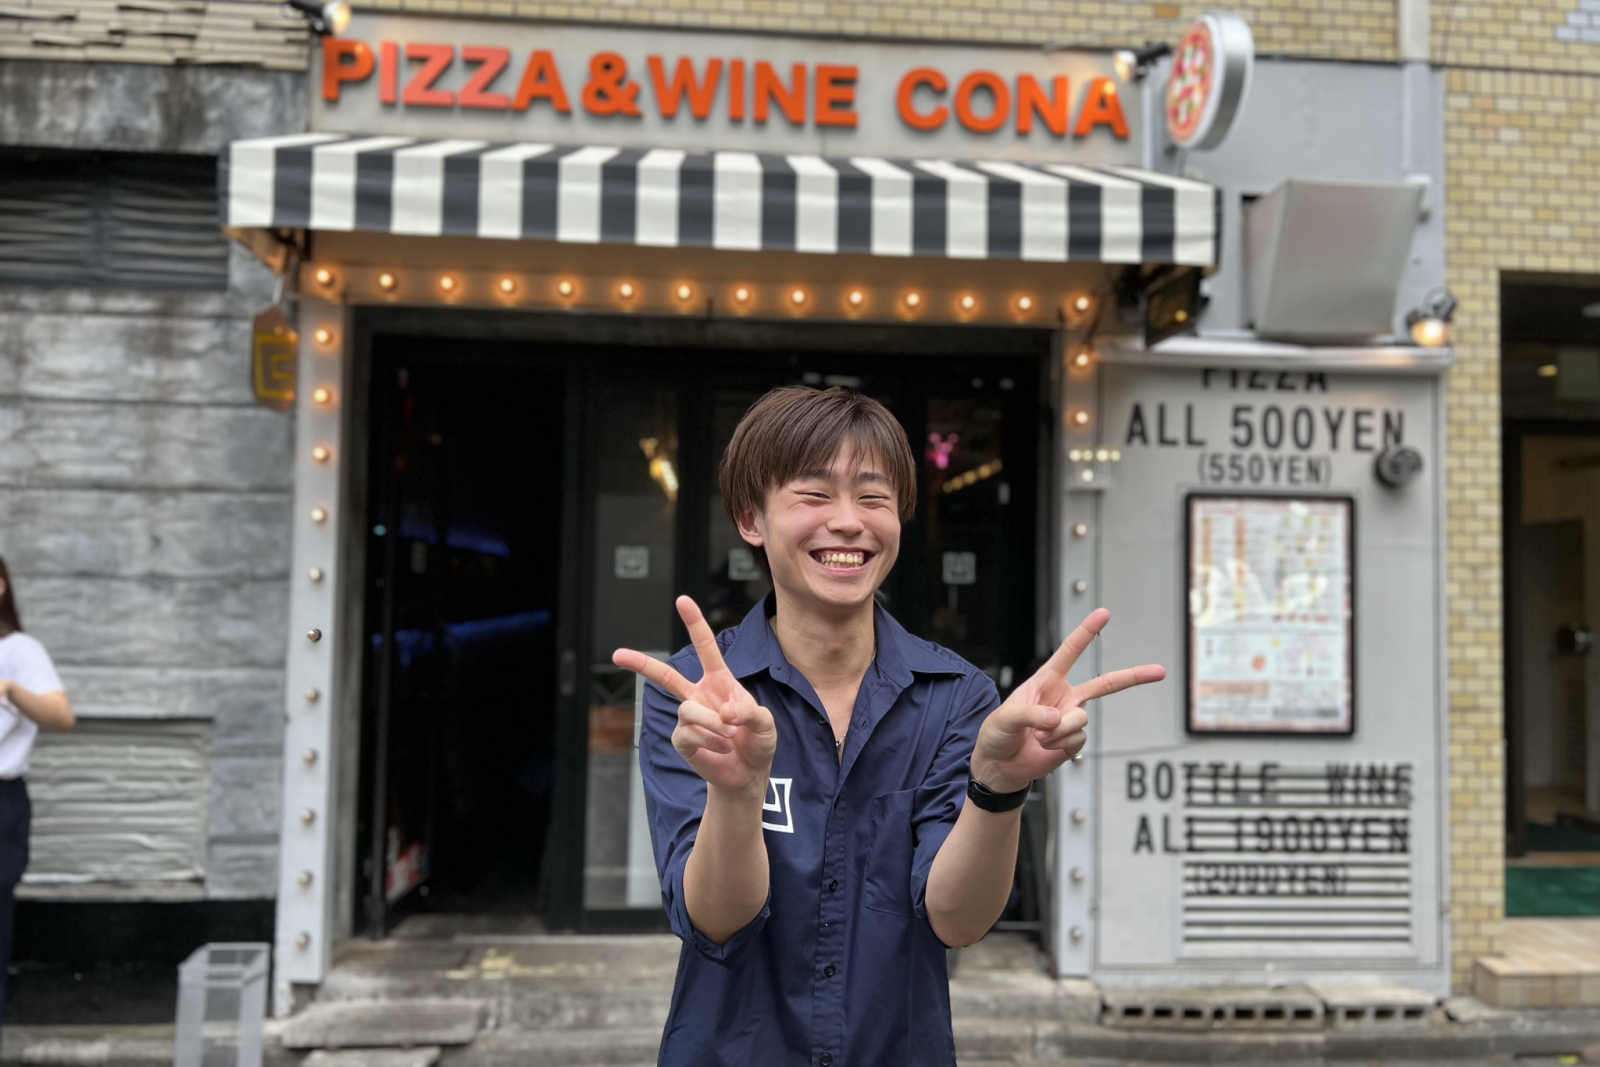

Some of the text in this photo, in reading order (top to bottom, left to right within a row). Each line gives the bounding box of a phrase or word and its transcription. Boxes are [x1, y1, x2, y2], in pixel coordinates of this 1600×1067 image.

[321, 37, 1130, 138] PIZZA&WINE CONA
[1125, 402, 1405, 453] ALL 500YEN
[1199, 452, 1333, 486] (550YEN)
[1126, 760, 1412, 805] BOTTLE WINE
[1133, 814, 1410, 853] ALL 1900YEN
